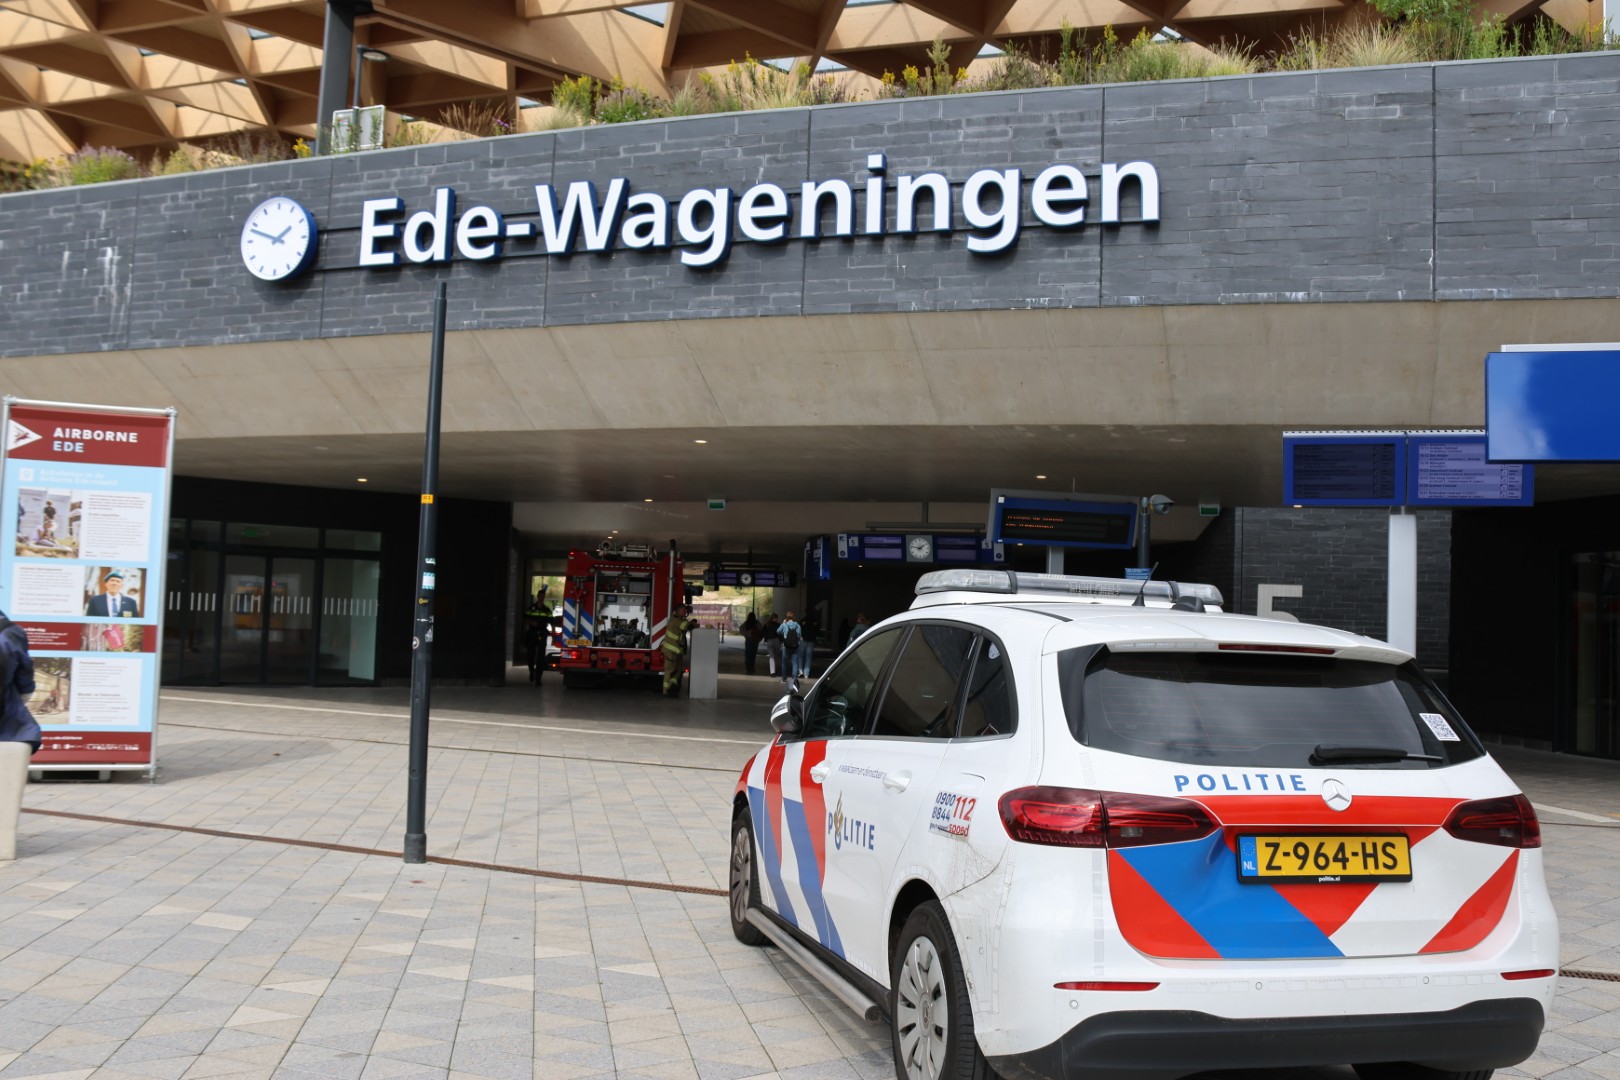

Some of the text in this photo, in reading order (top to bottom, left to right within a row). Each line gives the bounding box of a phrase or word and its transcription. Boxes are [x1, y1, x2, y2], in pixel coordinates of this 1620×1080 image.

[359, 154, 1161, 267] Ede-Wageningen
[53, 427, 138, 443] AIRBORNE
[53, 441, 84, 453] EDE
[1173, 774, 1307, 792] POLITIE
[936, 791, 957, 806] 0900
[931, 806, 951, 822] 8844
[953, 796, 977, 821] 112
[828, 809, 875, 851] POLITIE
[1264, 841, 1399, 872] Z-964-HS
[1243, 861, 1256, 871] NL
